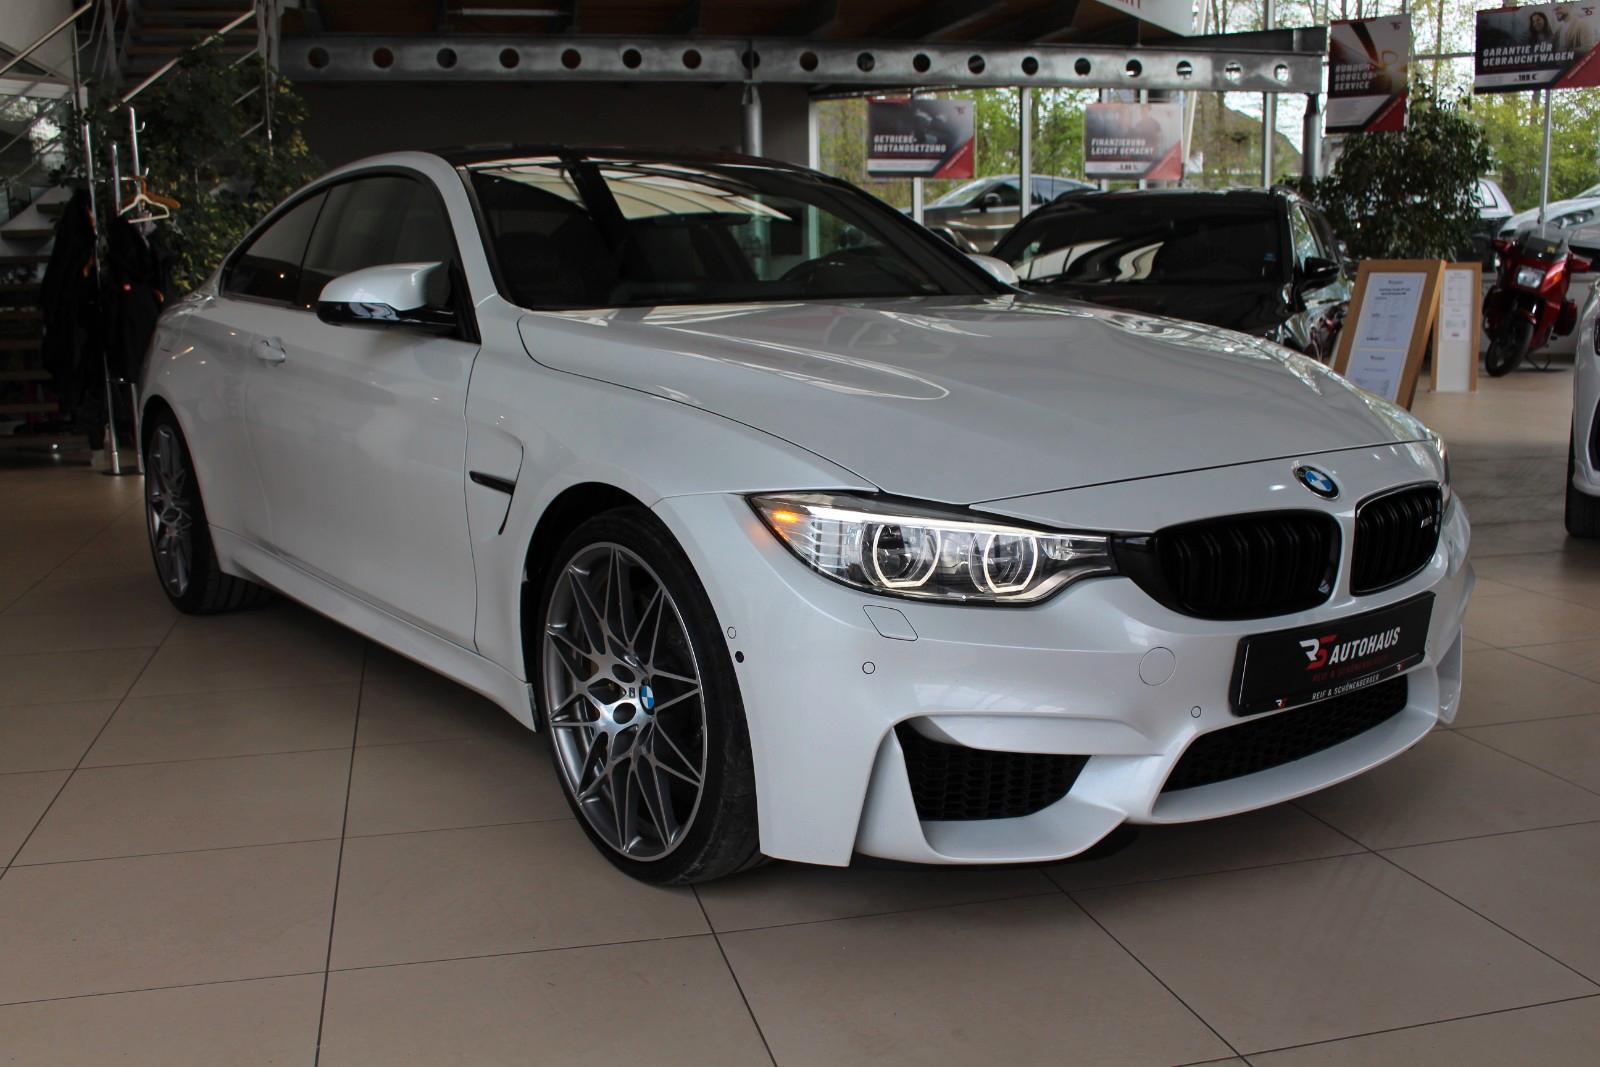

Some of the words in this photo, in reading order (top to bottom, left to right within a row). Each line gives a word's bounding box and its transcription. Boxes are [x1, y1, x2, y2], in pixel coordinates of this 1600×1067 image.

[1483, 45, 1531, 57] GARANTIE
[1534, 41, 1553, 52] FÜR
[1483, 51, 1575, 66] GEBRAUCHTWAGEN
[1334, 80, 1370, 92] SERVICE
[874, 134, 917, 143] GETRIEBE-
[1091, 138, 1147, 146] FINANZIERUNG
[873, 143, 946, 153] INSTANDSETZUNG
[1091, 147, 1117, 155] LEICHT
[1119, 147, 1154, 155] GEMACHT
[1328, 626, 1400, 665] AUTOHAUS
[1312, 689, 1327, 700] REIF
[1327, 688, 1332, 697] &
[1334, 673, 1380, 695] SCHÖNENBERGER
